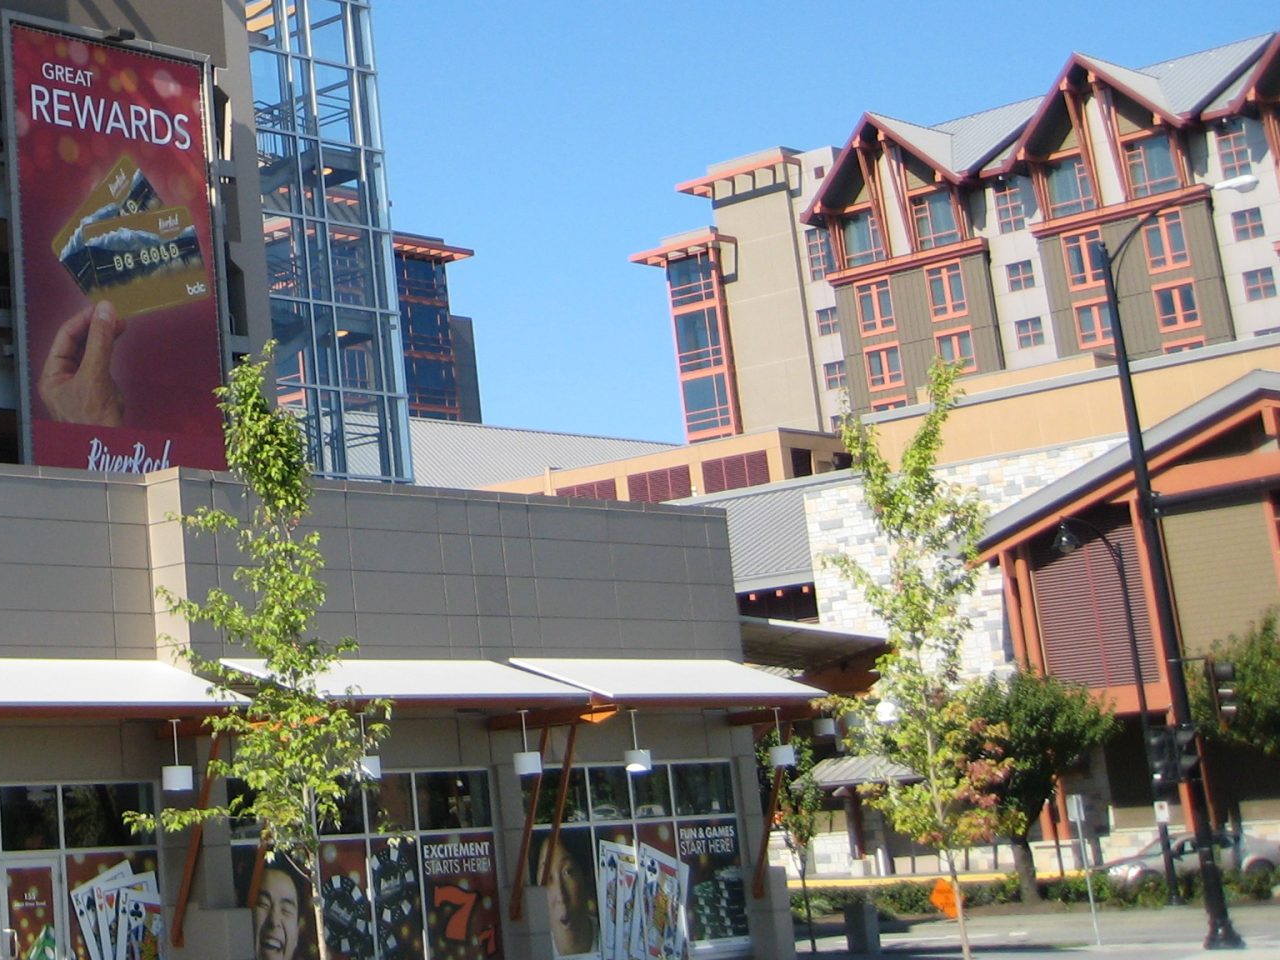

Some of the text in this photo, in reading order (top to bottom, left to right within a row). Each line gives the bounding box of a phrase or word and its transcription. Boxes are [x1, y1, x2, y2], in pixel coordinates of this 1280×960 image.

[42, 62, 93, 87] GREAT
[31, 84, 191, 150] REWARDS
[113, 243, 180, 271] BC GOLD
[680, 827, 698, 839] FUN
[705, 826, 735, 838] GAMES
[423, 842, 490, 859] EXCITEMENT
[680, 838, 734, 856] START HERE!
[424, 857, 492, 876] STARTS HERE!
[434, 884, 477, 941] 7
